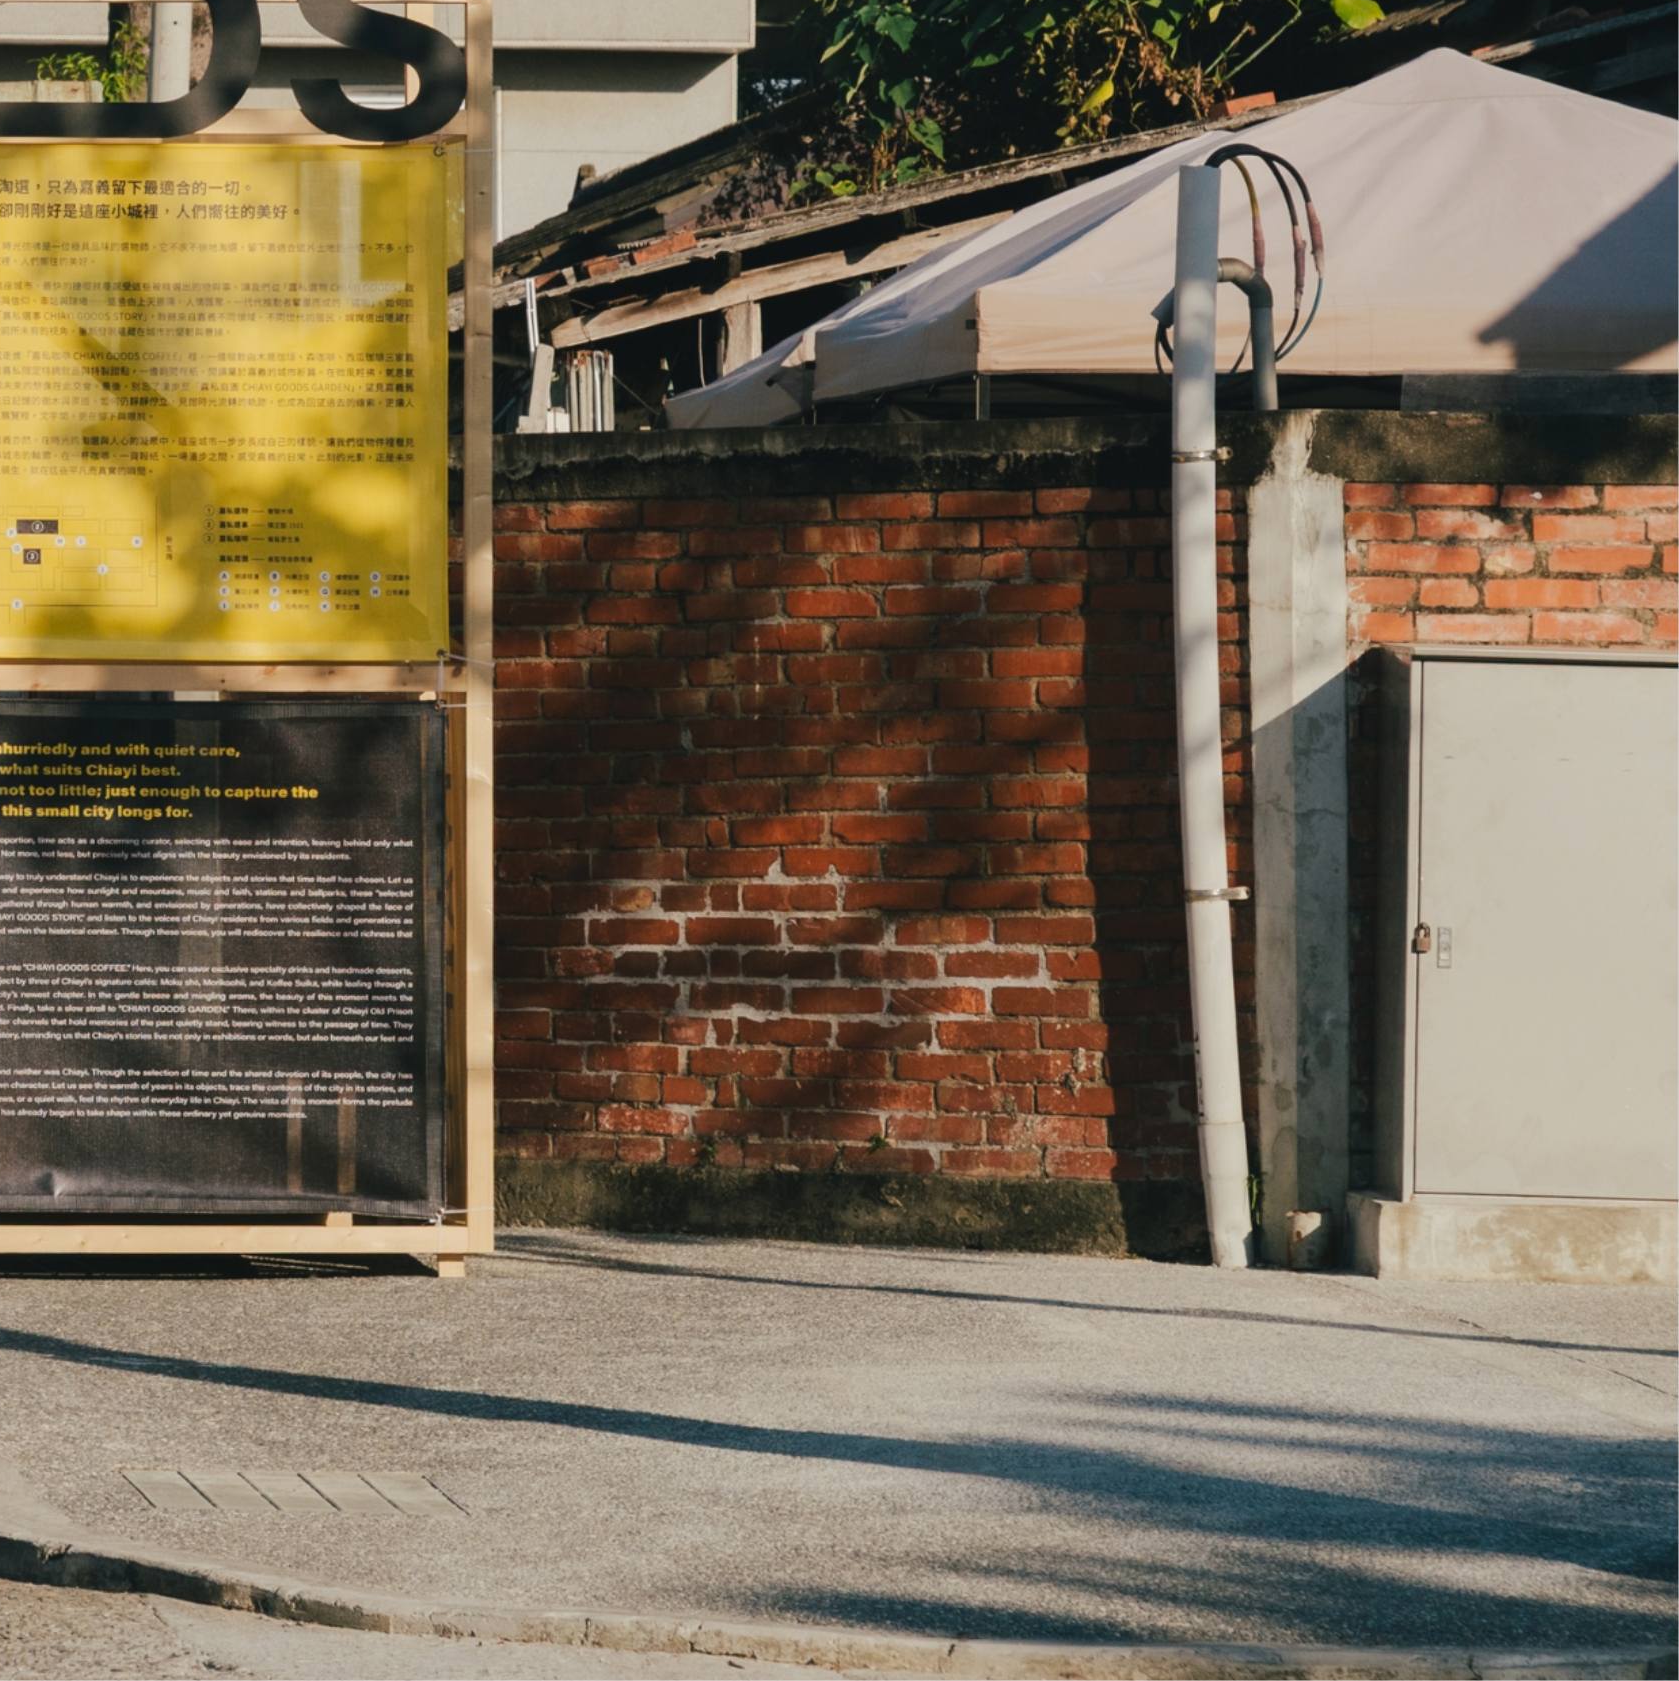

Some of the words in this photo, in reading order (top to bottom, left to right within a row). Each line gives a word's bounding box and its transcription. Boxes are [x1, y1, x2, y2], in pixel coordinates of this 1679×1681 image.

[82, 743, 111, 756] and
[116, 743, 150, 756] with
[154, 743, 195, 758] quiet
[199, 746, 241, 759] care,
[0, 763, 39, 775] what
[43, 763, 82, 776] suits
[87, 764, 138, 778] Chiayi
[142, 764, 181, 776] best.
[0, 784, 25, 797] not
[29, 784, 55, 797] too
[60, 784, 101, 799] little;
[106, 784, 136, 799] just
[140, 785, 200, 799] enough
[205, 785, 221, 798] to
[225, 785, 288, 800] capture
[291, 786, 319, 798] the
[2, 804, 33, 817] this
[36, 804, 79, 817] small
[84, 805, 114, 819] city
[118, 805, 162, 820] longs
[166, 805, 193, 818] for.
